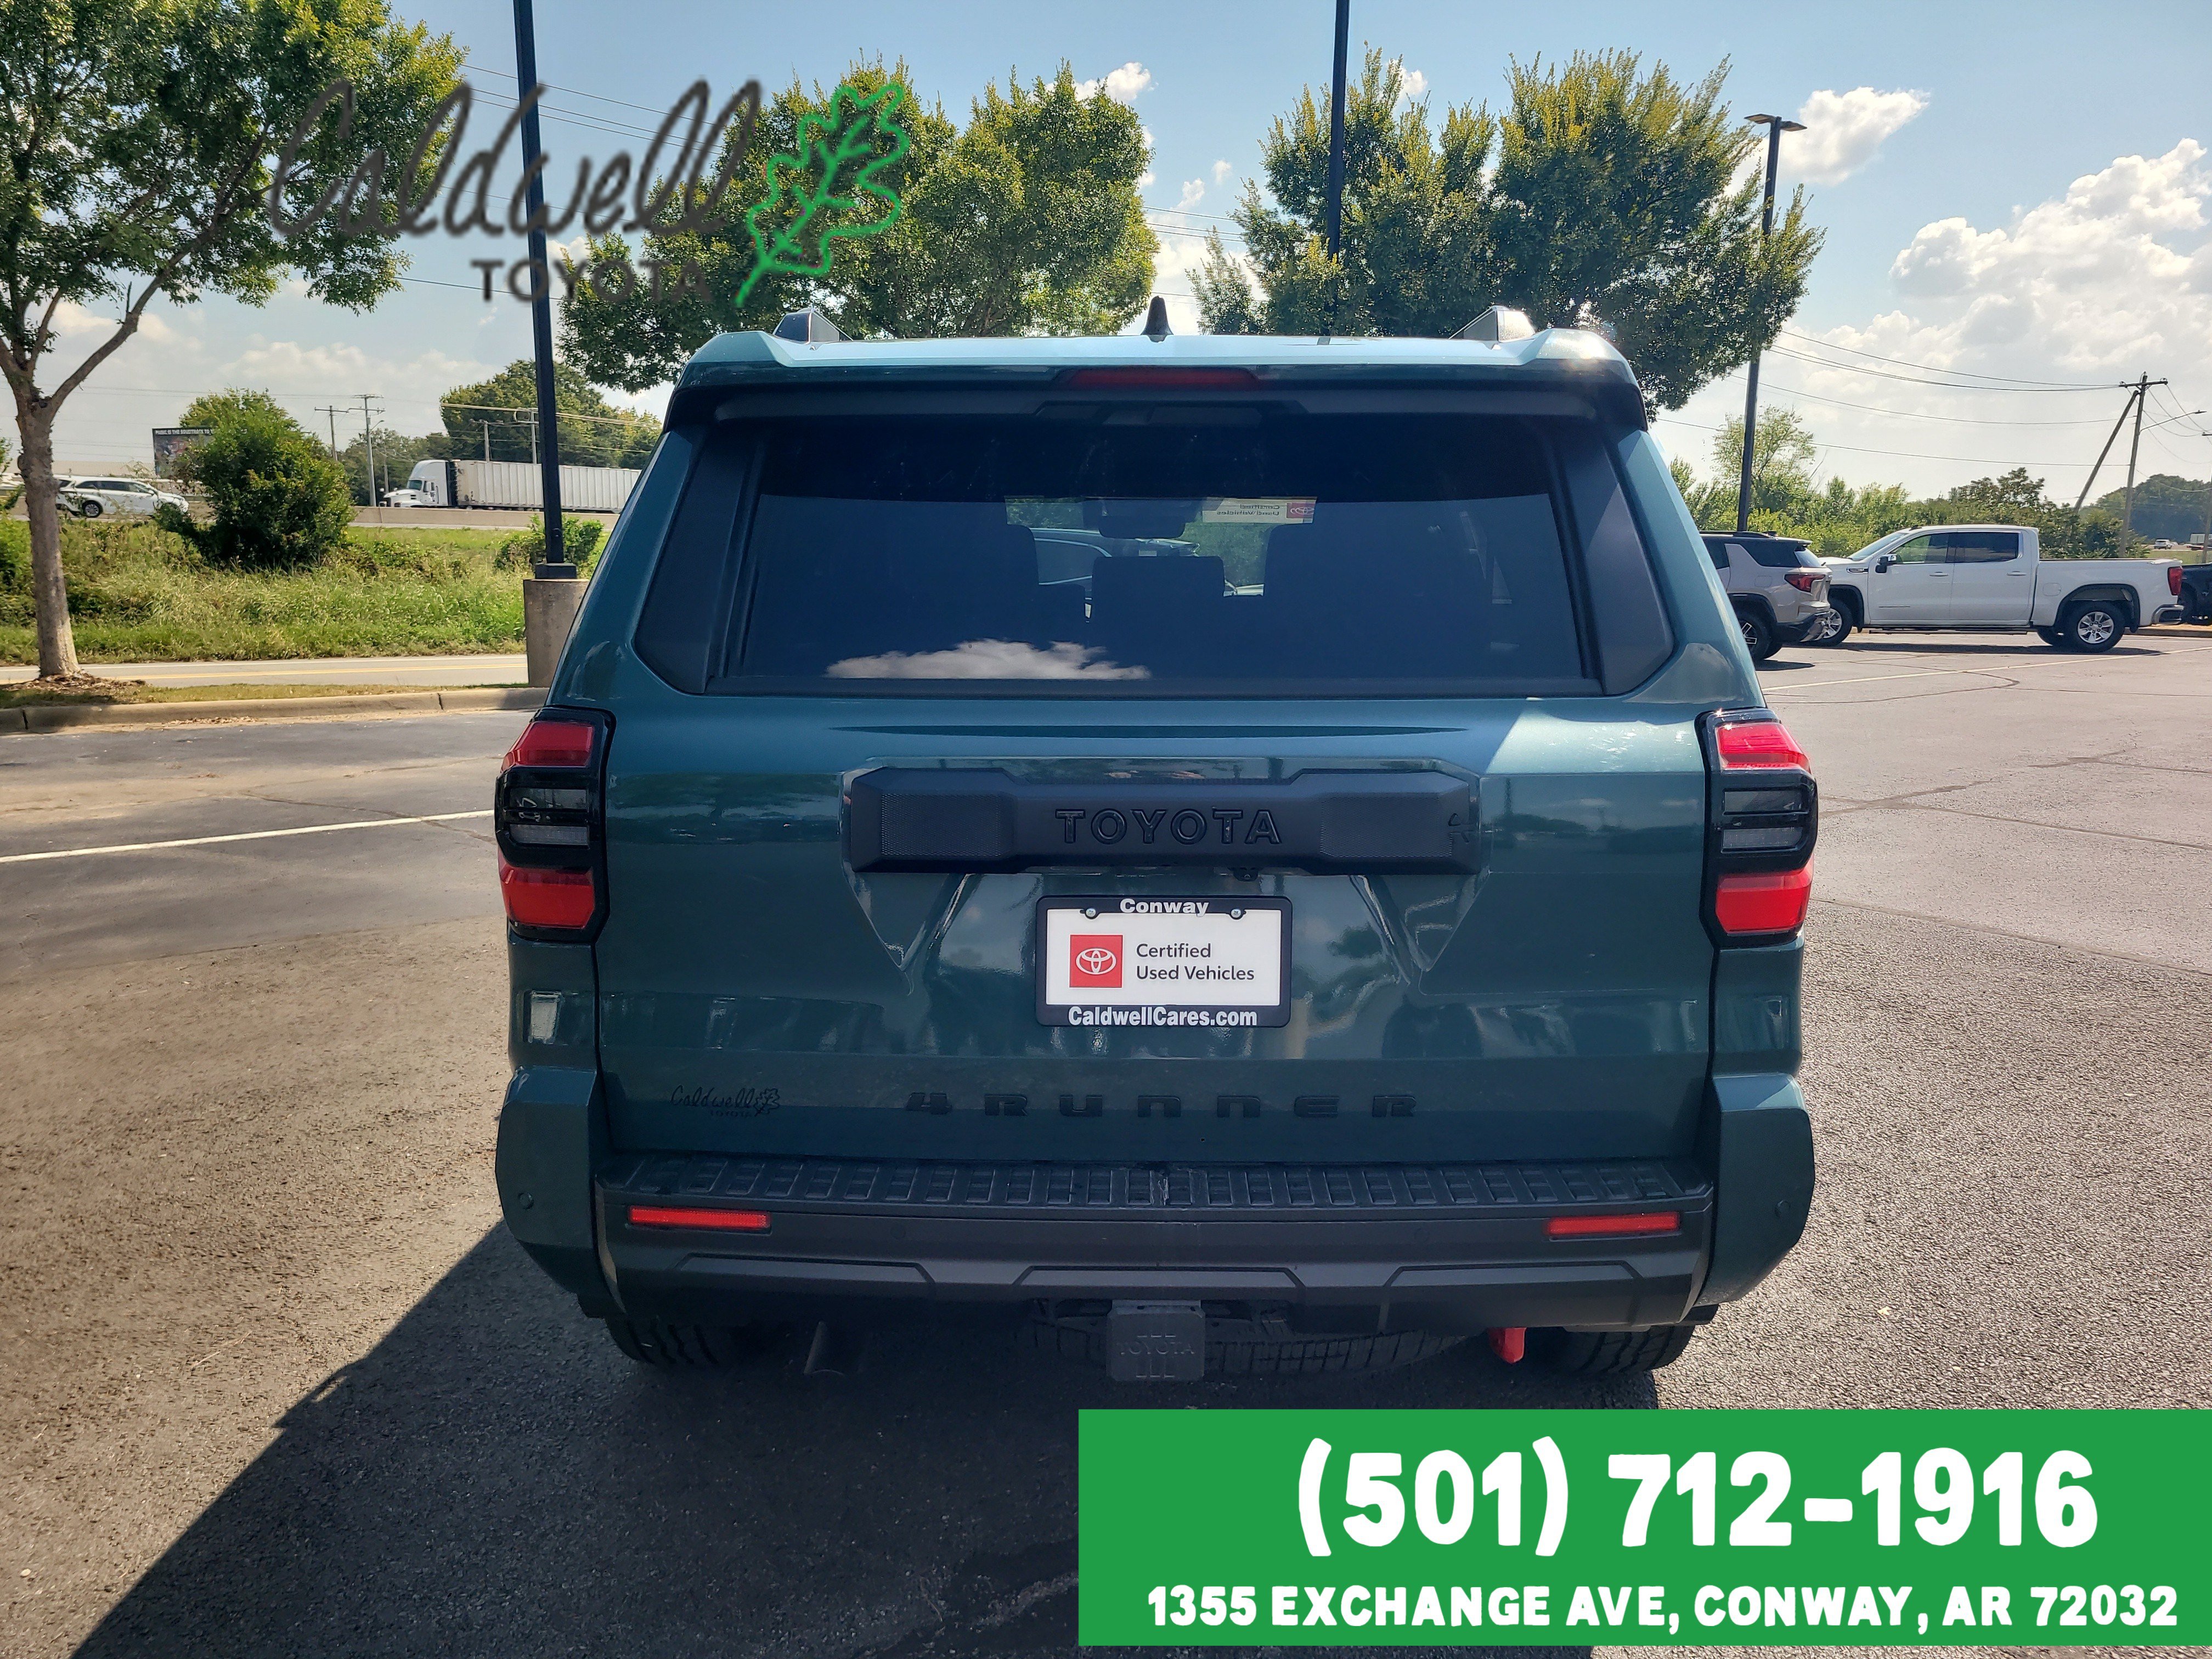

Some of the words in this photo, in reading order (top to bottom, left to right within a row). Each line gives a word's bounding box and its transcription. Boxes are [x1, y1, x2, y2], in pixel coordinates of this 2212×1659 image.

[1054, 808, 1283, 845] TOYOTA
[1119, 898, 1210, 917] Conway
[1136, 943, 1211, 958] Certified
[1136, 964, 1179, 980] Used
[1184, 964, 1255, 981] Vehicles
[1068, 1006, 1258, 1026] CaldwellCares.com
[670, 1084, 756, 1108] Caldwell
